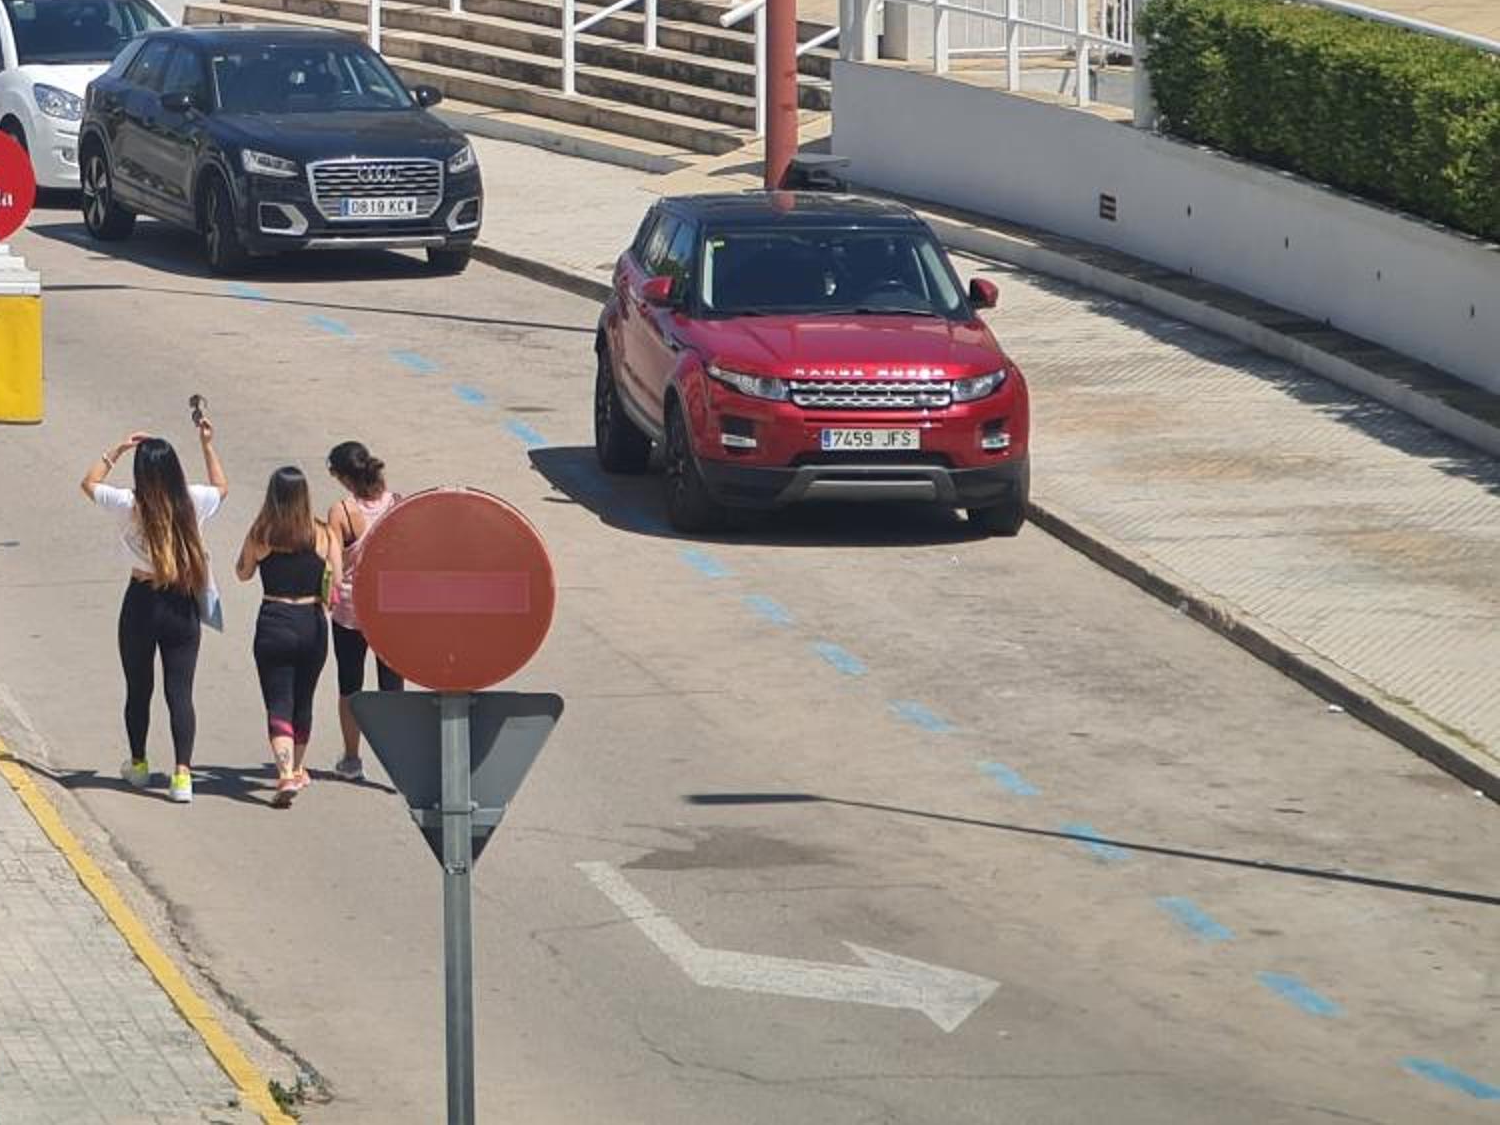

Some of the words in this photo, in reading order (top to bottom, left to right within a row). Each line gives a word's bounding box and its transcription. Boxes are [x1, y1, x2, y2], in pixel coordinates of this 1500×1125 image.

[351, 200, 386, 214] 0819
[833, 431, 873, 447] 7459
[881, 431, 912, 447] JFS
